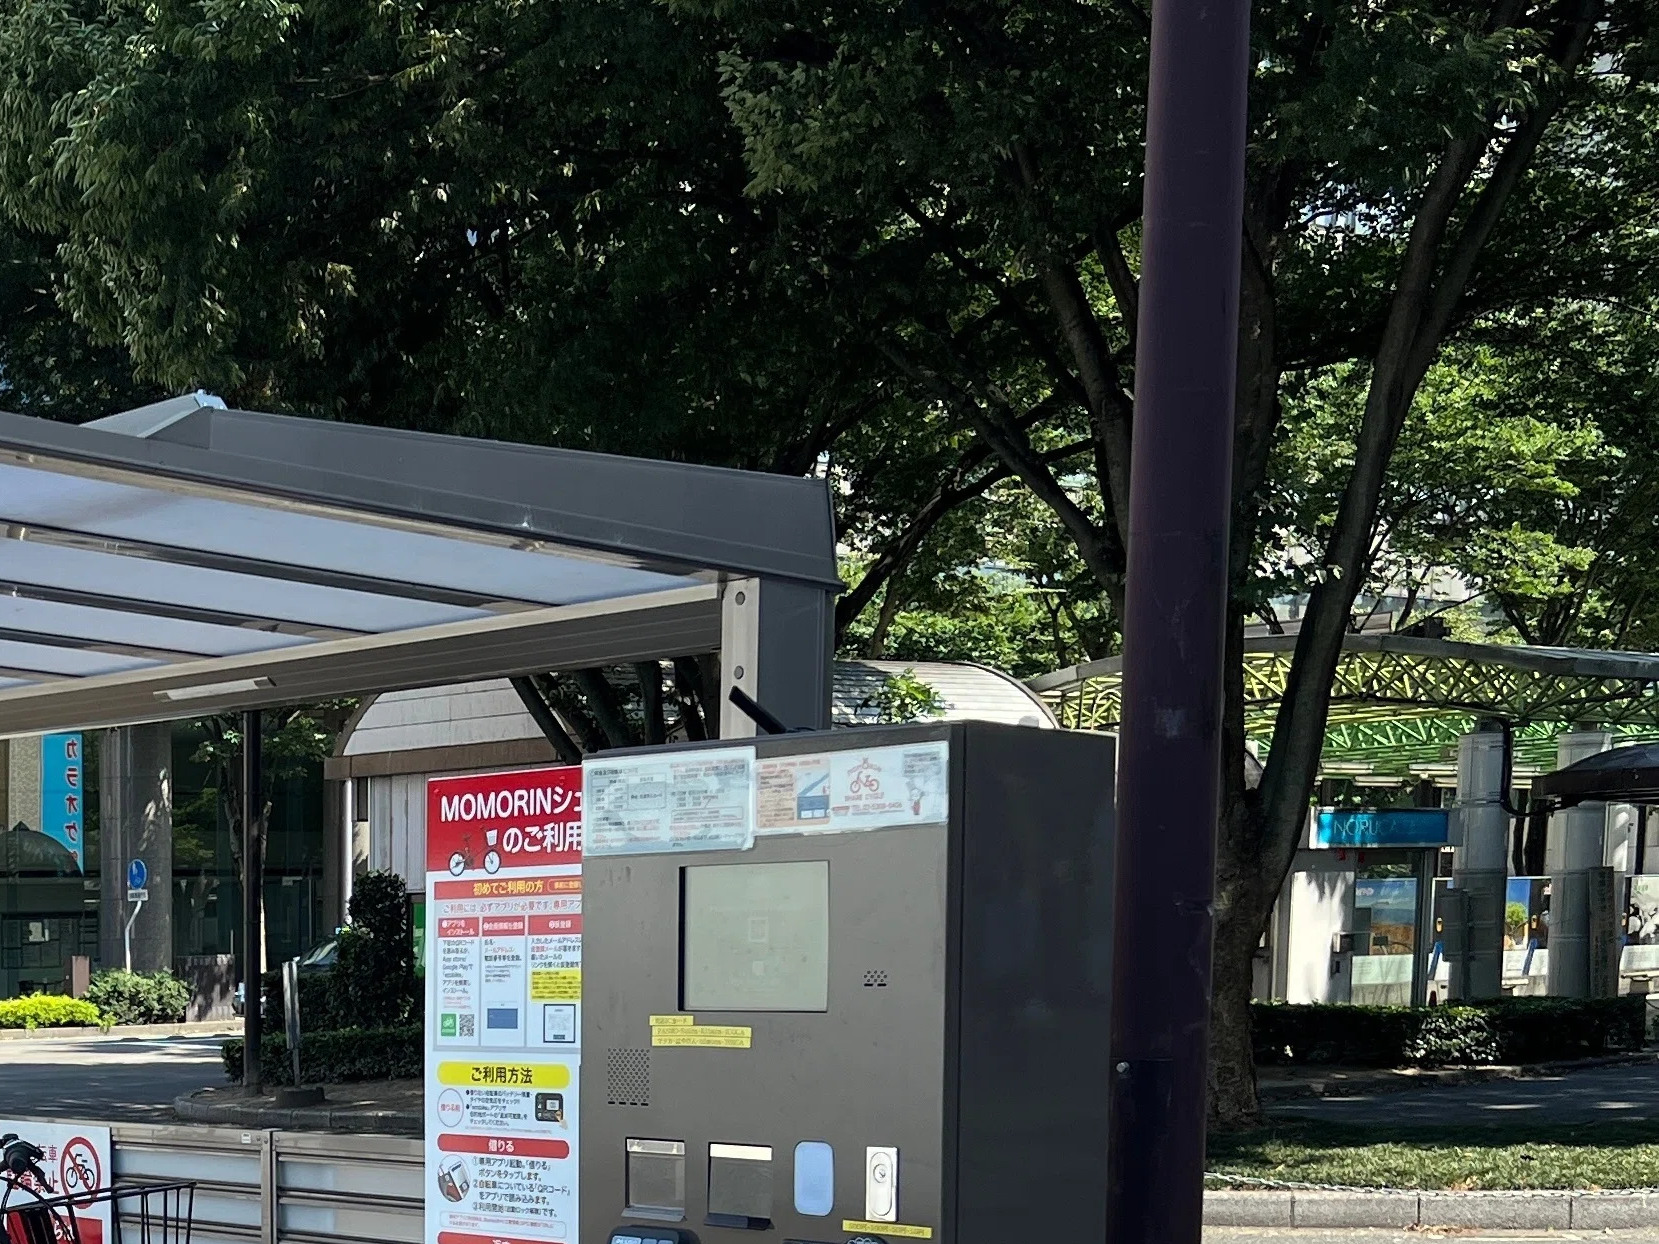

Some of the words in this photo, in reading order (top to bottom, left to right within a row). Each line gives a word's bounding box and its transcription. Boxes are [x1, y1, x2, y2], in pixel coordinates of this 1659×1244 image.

[473, 880, 544, 896] 初めてご利用の方
[471, 1066, 533, 1084] ご利用方法
[488, 1138, 515, 1153] 借りる
